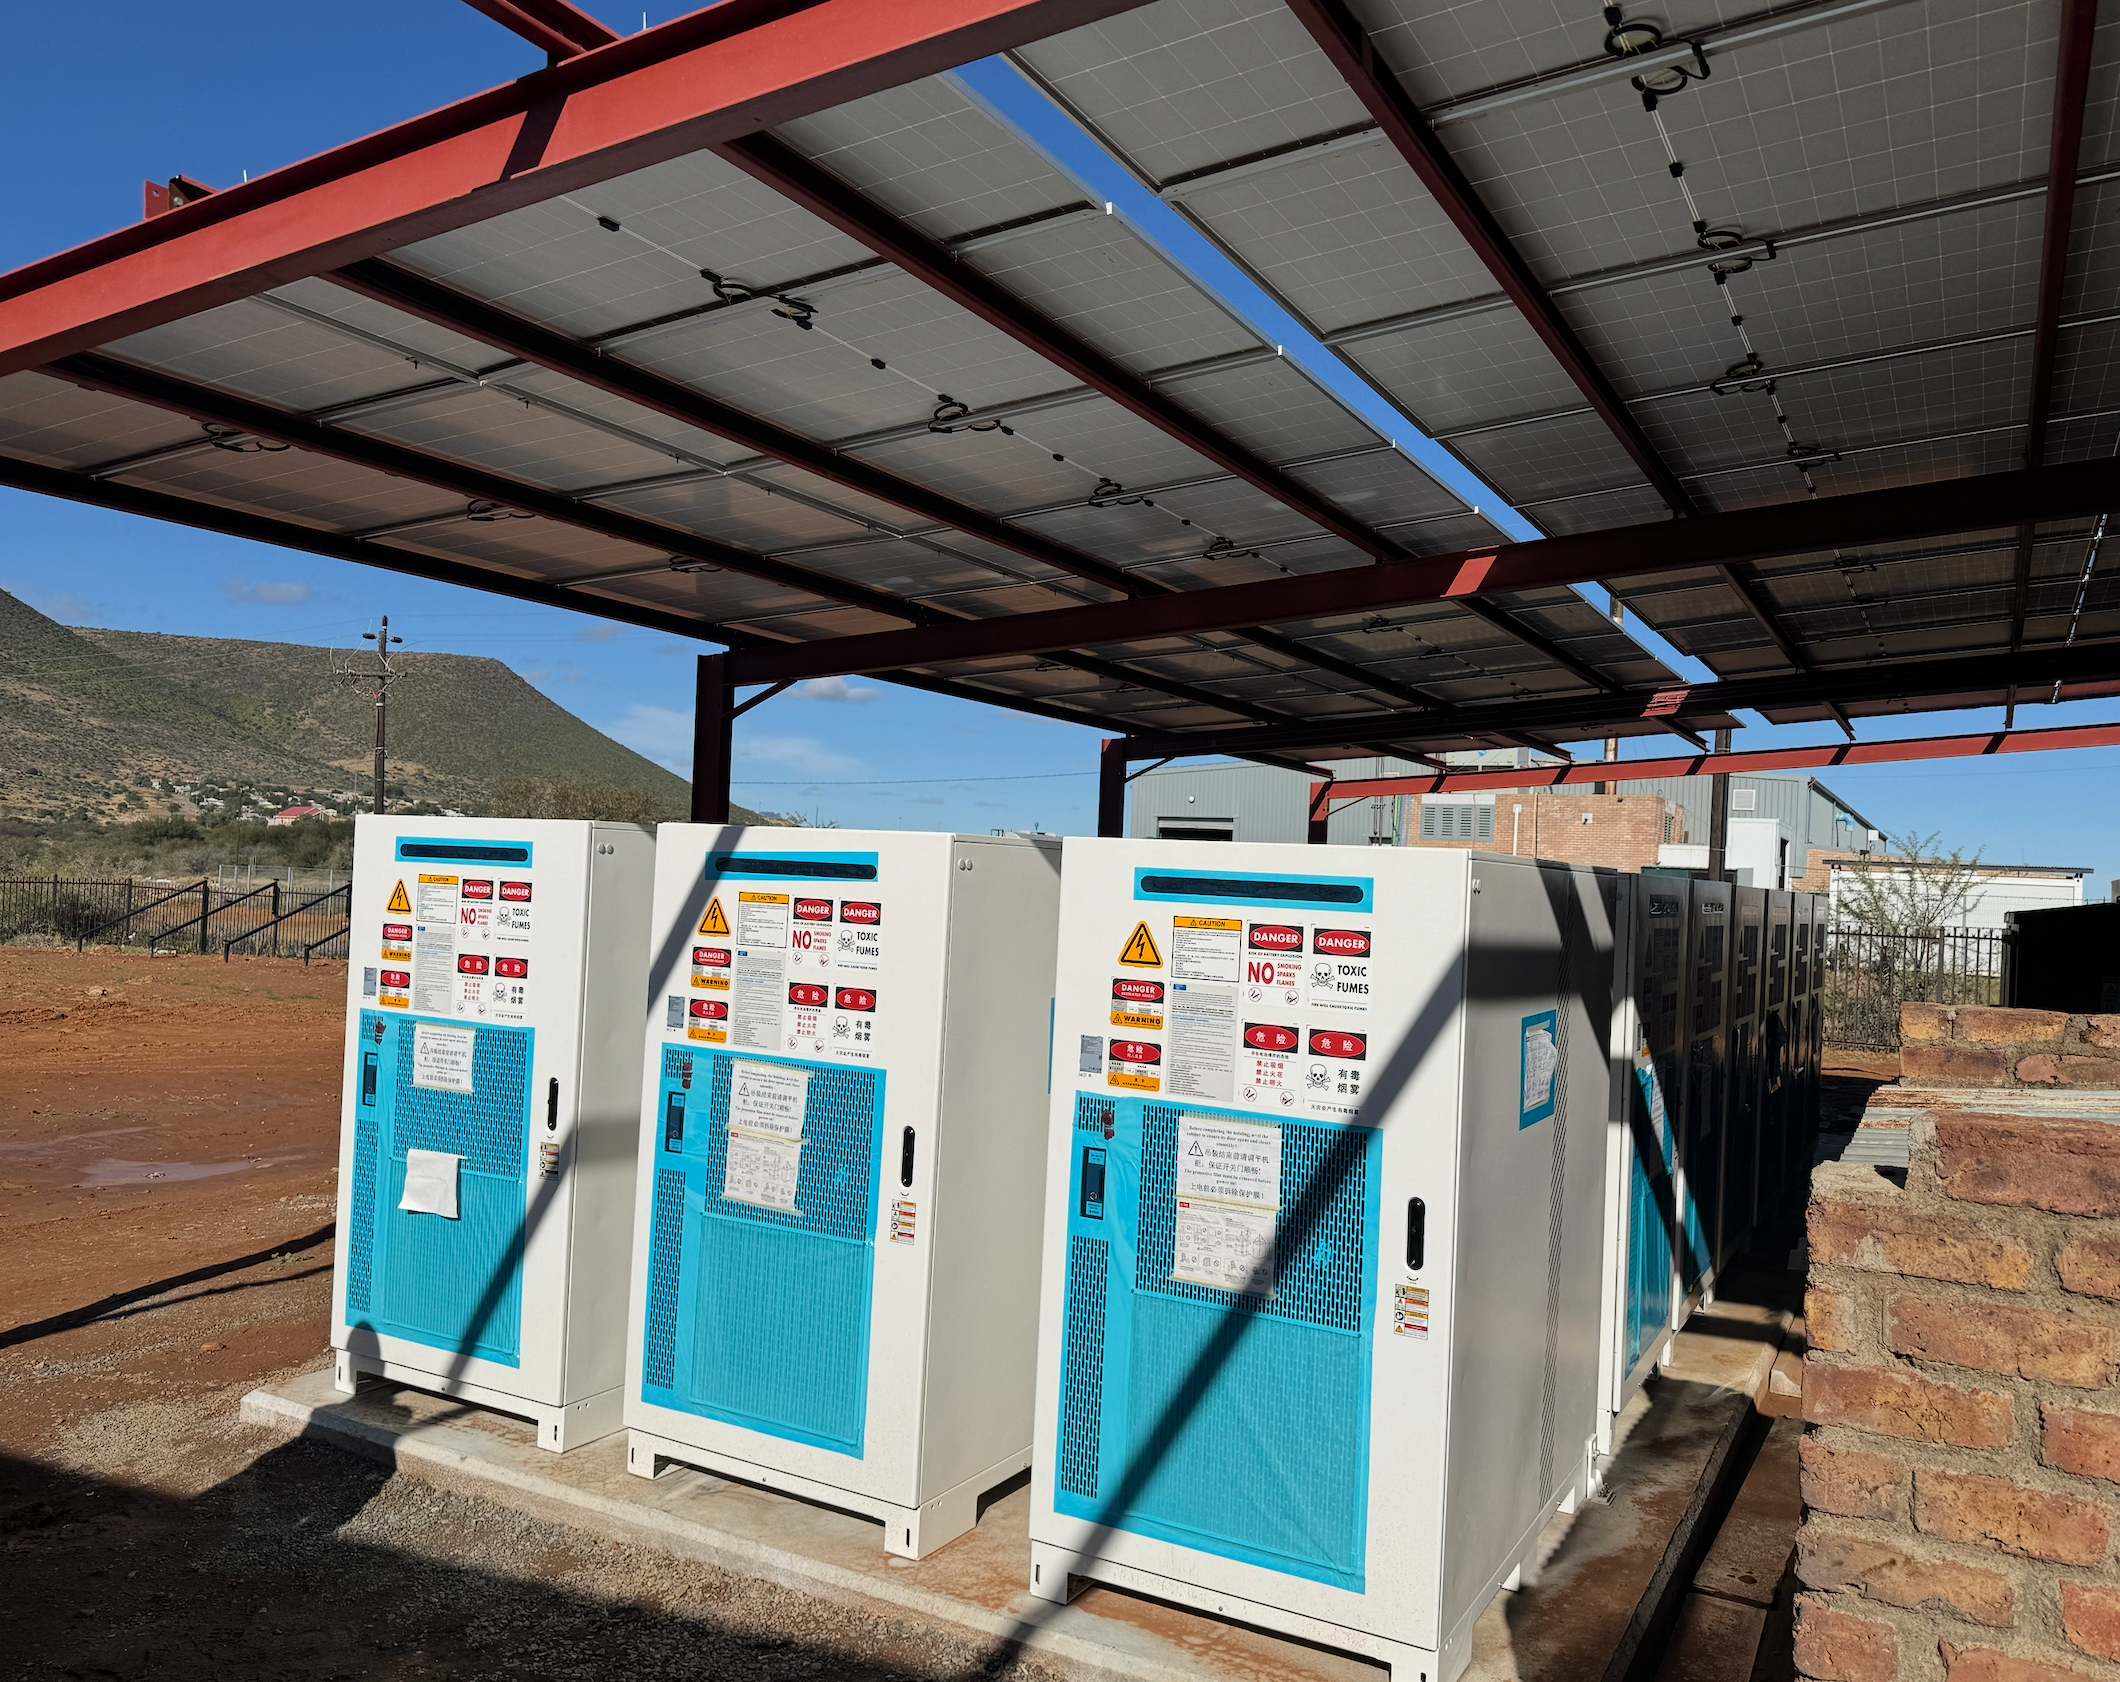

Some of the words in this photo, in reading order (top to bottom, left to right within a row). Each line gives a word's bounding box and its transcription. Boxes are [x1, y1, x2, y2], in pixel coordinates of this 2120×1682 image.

[464, 885, 491, 894] DANGER
[502, 887, 530, 896] DANGER
[512, 908, 530, 917] TOXIC
[796, 904, 830, 915] DANGER
[843, 907, 878, 918] DANGER
[460, 907, 476, 925] NO
[511, 920, 531, 930] FUMES
[792, 930, 812, 949] NO
[857, 931, 878, 942] TOXIC
[1253, 932, 1299, 944] DANGER
[1318, 936, 1366, 950] DANGER
[699, 951, 725, 960] DANGER
[855, 946, 879, 957] FUMES
[1247, 961, 1275, 985] NO
[1337, 964, 1367, 977] TOXIC
[701, 978, 729, 986] WARNING
[1121, 983, 1155, 994] DANGER
[1336, 981, 1369, 995] FUMES
[1124, 1015, 1161, 1024] WARNING
[1255, 1031, 1286, 1045] 危险
[1126, 1043, 1144, 1054] 危险
[1320, 1037, 1354, 1052] 危险
[1256, 1060, 1284, 1069] 禁止吸烟
[1256, 1069, 1283, 1078] 禁止火花
[1338, 1068, 1360, 1081] 有毒
[1337, 1082, 1360, 1095] 烟雾
